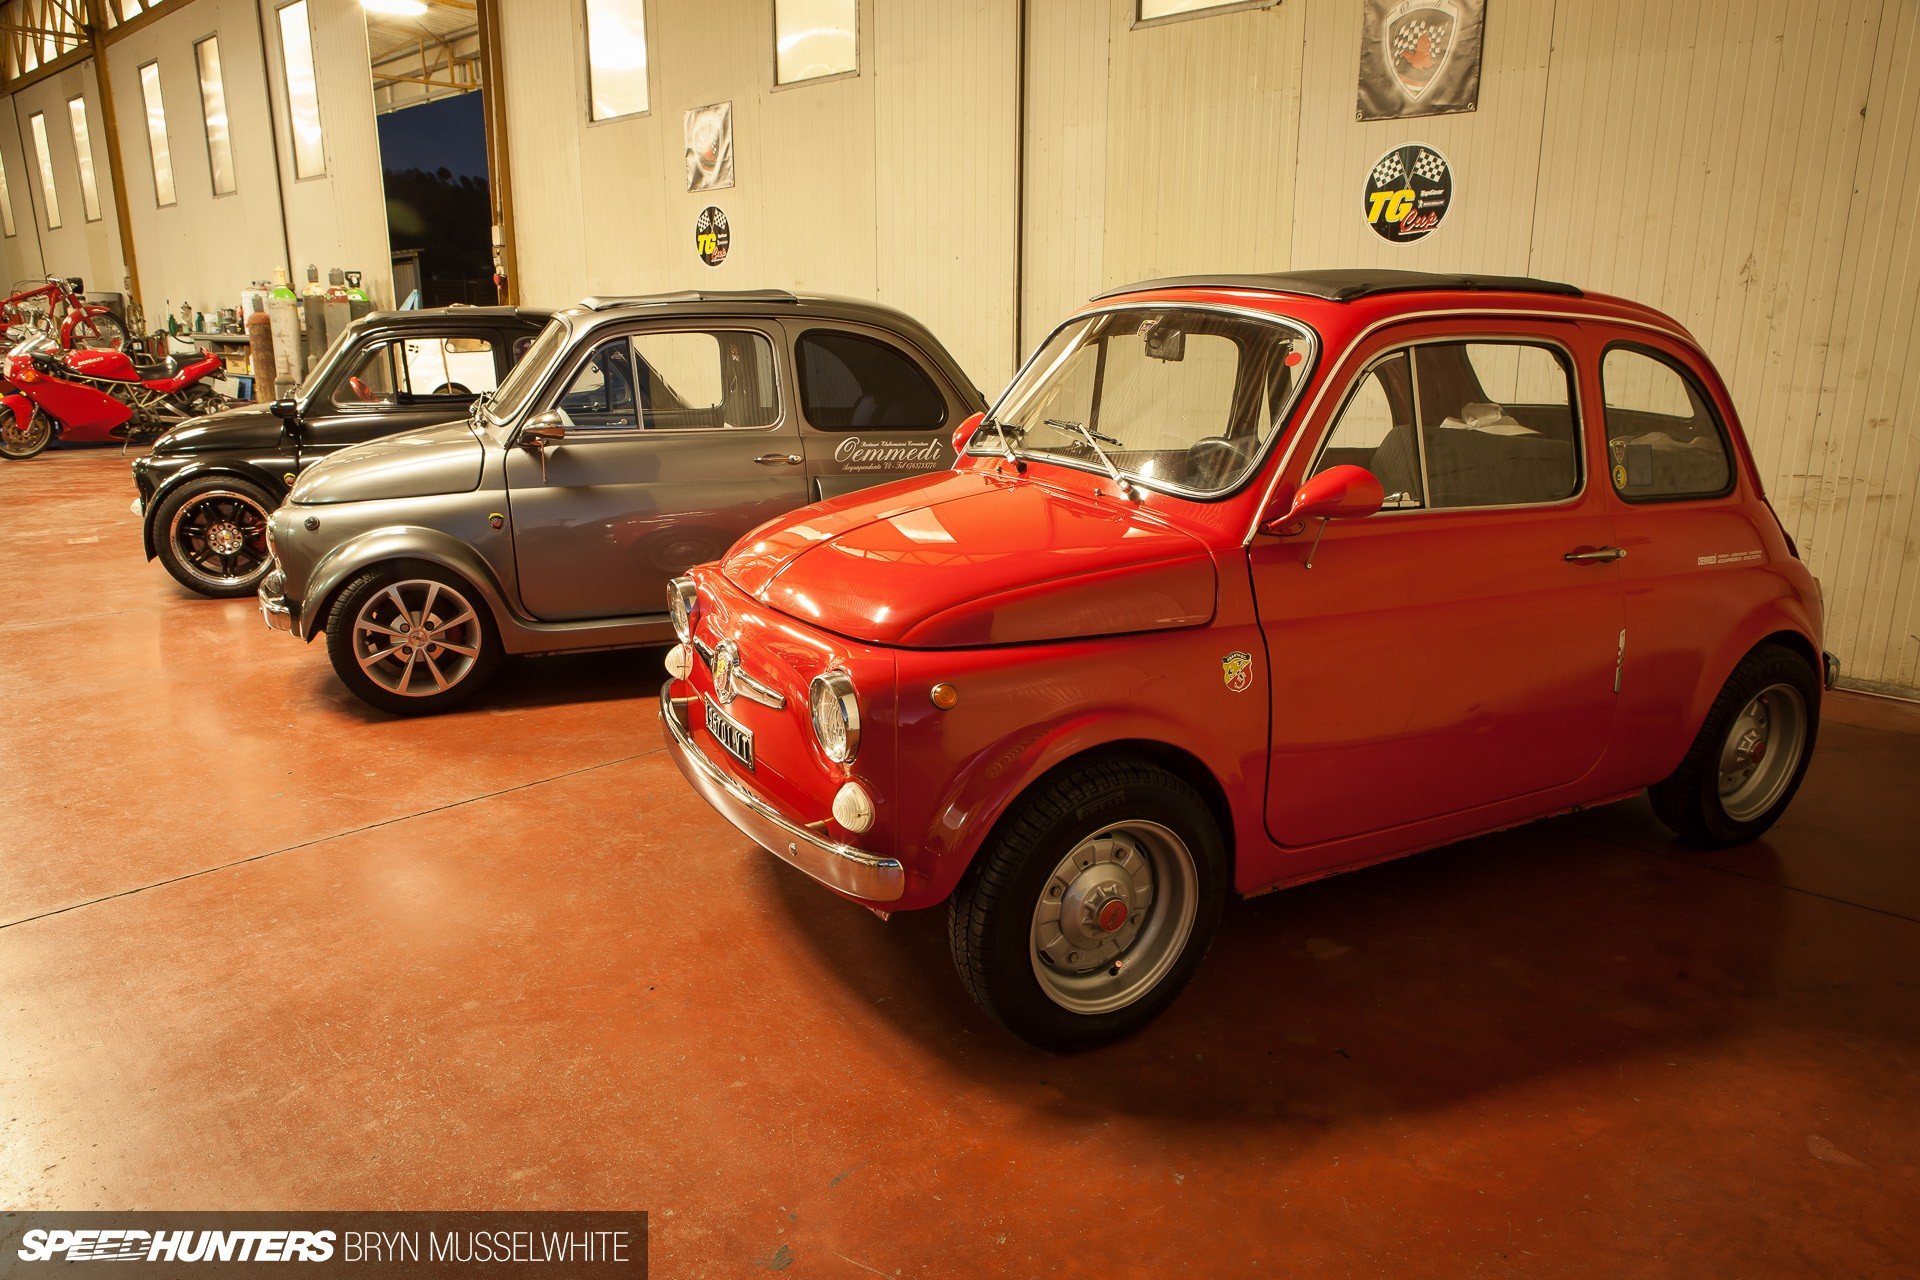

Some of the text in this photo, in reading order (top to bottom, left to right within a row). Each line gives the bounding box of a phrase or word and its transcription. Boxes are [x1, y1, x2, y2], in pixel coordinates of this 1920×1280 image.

[1366, 189, 1416, 224] TG
[1399, 208, 1440, 233] Cup
[697, 233, 717, 256] TG
[77, 356, 104, 366] DUCATI
